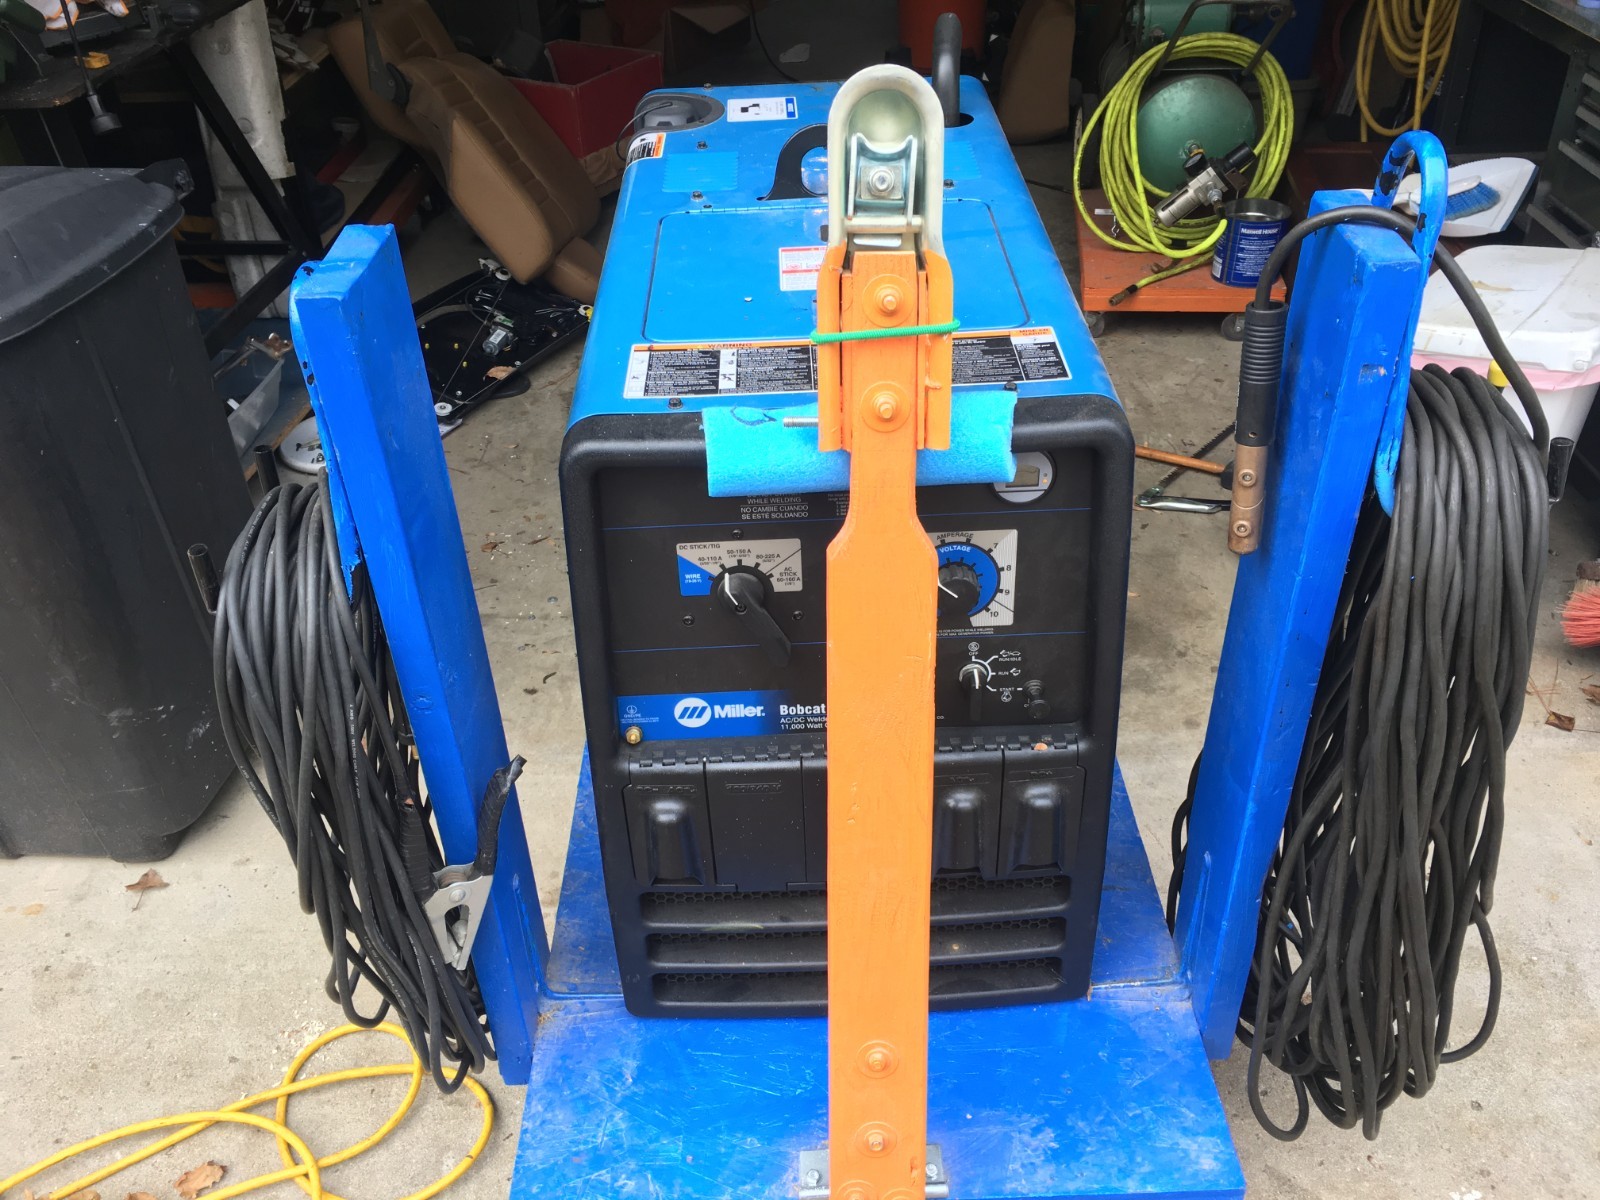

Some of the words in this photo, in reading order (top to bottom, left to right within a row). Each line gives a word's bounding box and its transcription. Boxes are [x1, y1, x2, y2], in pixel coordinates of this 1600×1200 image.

[936, 532, 974, 540] AMPERAGE
[940, 545, 972, 553] VOLTAGE
[779, 703, 827, 716] Bobcat
